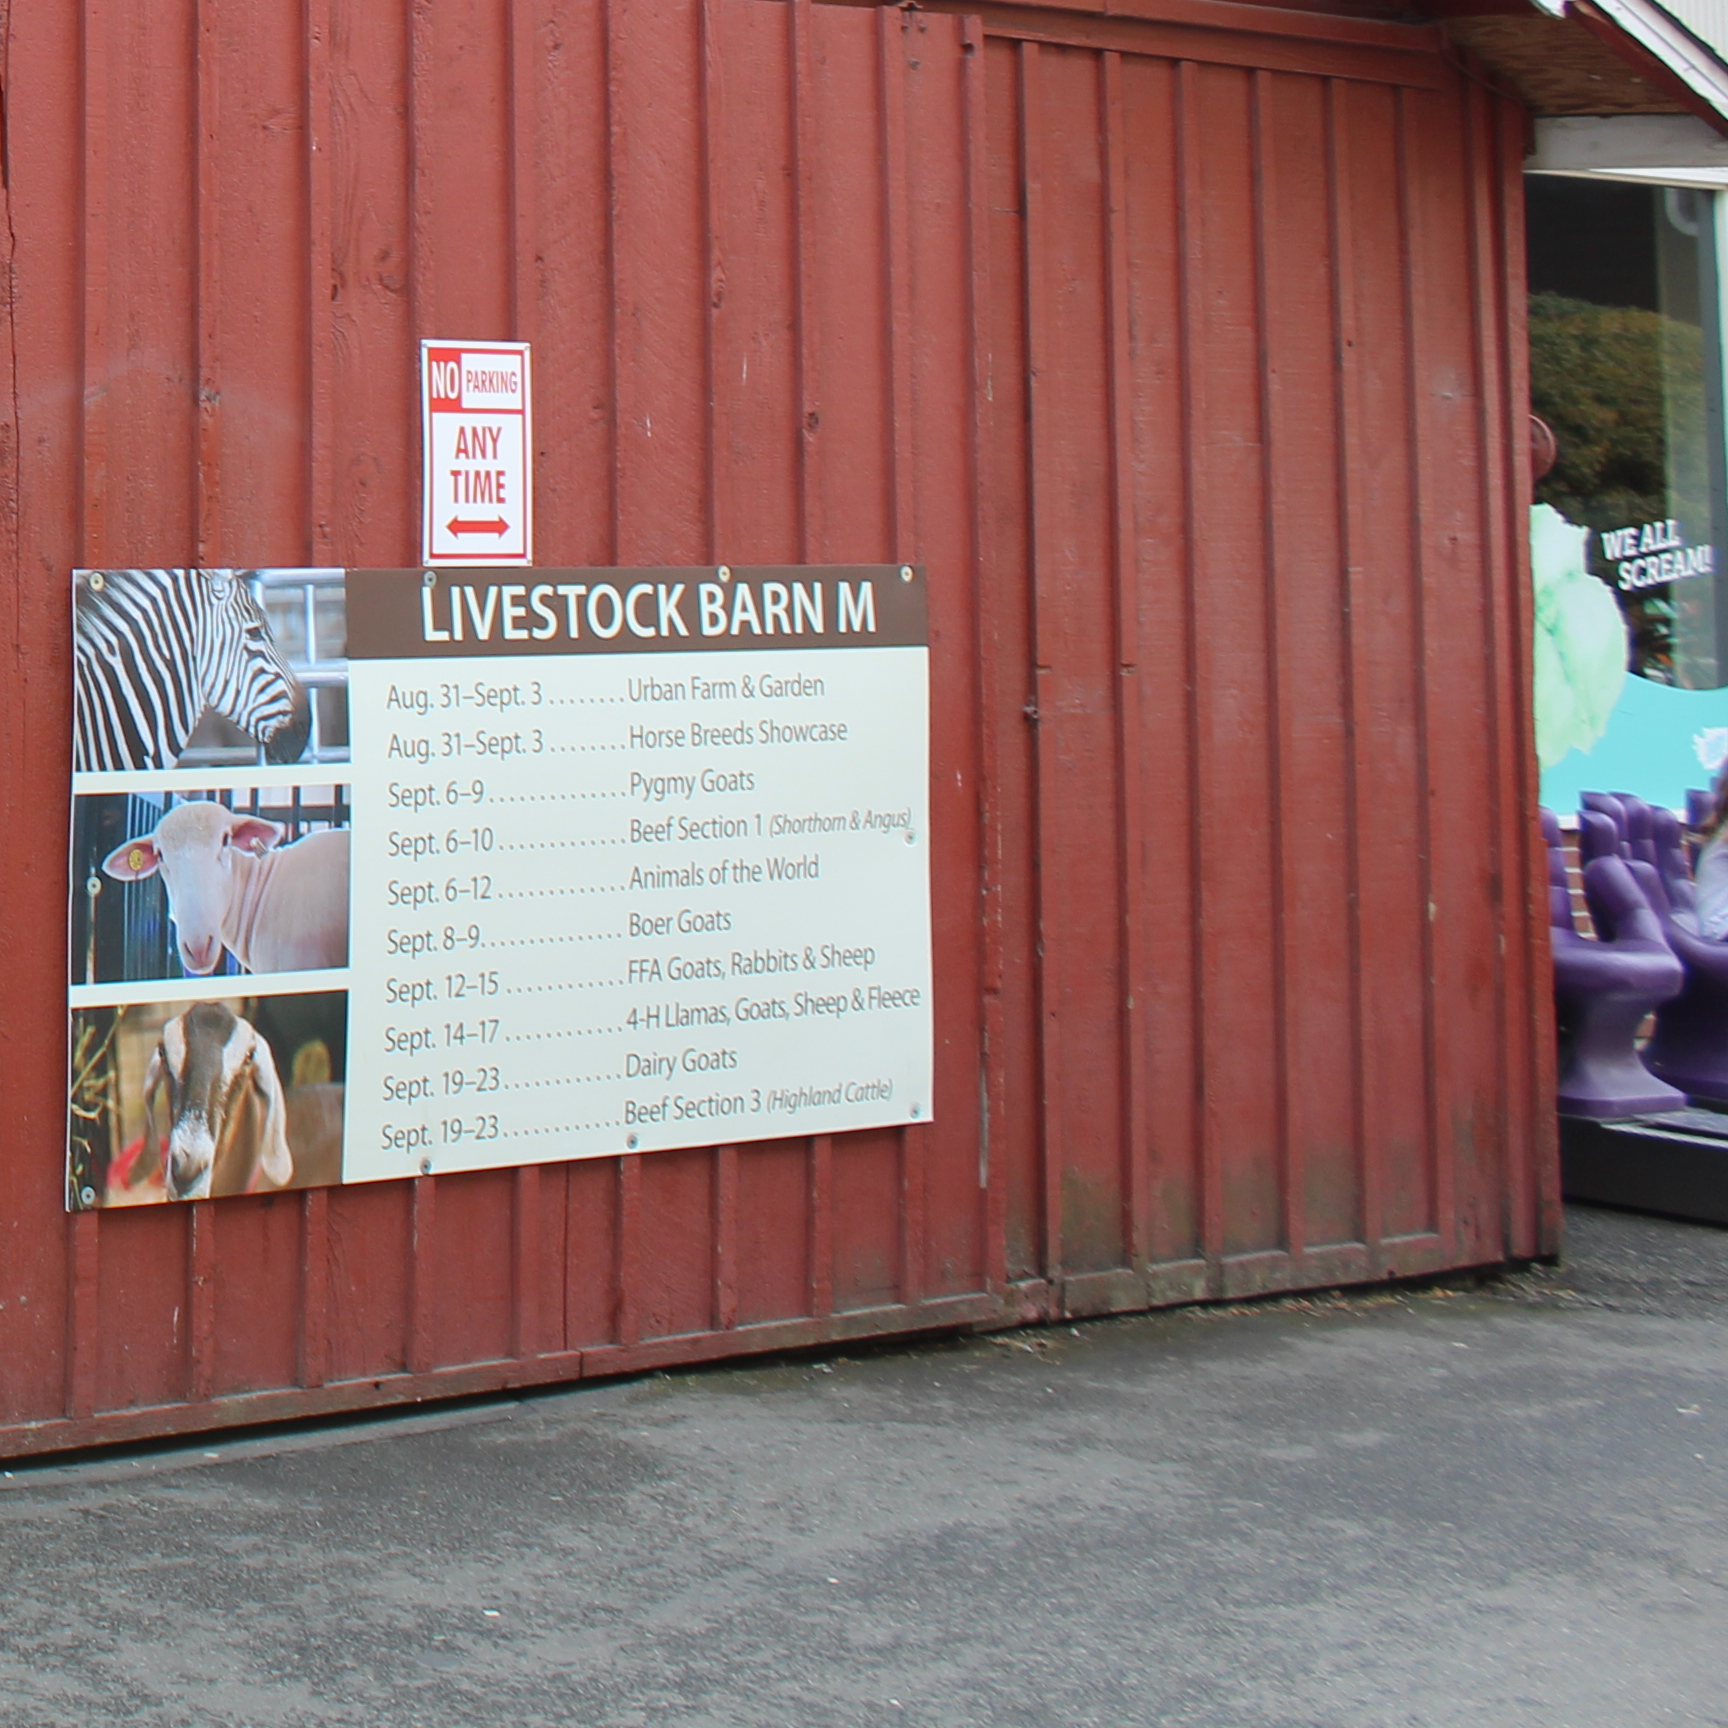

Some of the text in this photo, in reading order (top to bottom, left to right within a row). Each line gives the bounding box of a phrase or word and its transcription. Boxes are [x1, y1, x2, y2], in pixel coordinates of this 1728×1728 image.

[432, 361, 517, 399] NO PARKING
[455, 426, 502, 460] ANY
[450, 470, 506, 504] TIME
[1601, 519, 1682, 560] WE ALL
[1618, 544, 1714, 591] SCREAM!
[422, 582, 875, 642] LIVESTOCK BARN M
[387, 685, 434, 716] Aug.
[531, 681, 542, 705] 3
[628, 677, 686, 702] Urban
[691, 676, 736, 700] Farm
[741, 675, 755, 698] &
[759, 673, 824, 698] Garden
[388, 734, 435, 764] Aug.
[532, 729, 543, 753] 3
[630, 725, 685, 749] Horse
[691, 720, 754, 746] Breeds
[759, 719, 847, 744] Showcase
[389, 782, 440, 813] Sept.
[631, 772, 696, 802] Pygmy
[701, 769, 754, 792] Goats
[389, 831, 440, 862] Sept.
[631, 817, 674, 845] Beef
[678, 815, 745, 840] Section
[754, 813, 762, 837] 1
[770, 812, 846, 838] (Shorthorn
[849, 810, 861, 830] &
[863, 807, 912, 831] Angus)
[388, 880, 439, 910] Sept.
[629, 862, 704, 890] Animals
[709, 859, 729, 885] of
[732, 859, 762, 883] the
[766, 854, 819, 881] World
[387, 929, 437, 959] Sept.
[630, 913, 673, 937] Boer
[678, 909, 731, 933] Goats
[386, 978, 437, 1008] Sept.
[629, 958, 662, 984] FFA
[667, 957, 726, 980] Goats,
[732, 949, 798, 976] Rabbits
[803, 946, 816, 970] &
[820, 944, 875, 971] Sheep
[385, 1027, 436, 1057] Sept.
[626, 1005, 660, 1030] 4-H
[665, 1002, 731, 1027] Llamas,
[735, 997, 789, 1021] Goats,
[794, 991, 848, 1019] Sheep
[851, 988, 865, 1011] &
[868, 985, 920, 1010] Fleece
[383, 1076, 434, 1105] Sept.
[626, 1052, 677, 1081] Dairy
[682, 1048, 737, 1072] Goats
[381, 1124, 432, 1154] Sept.
[625, 1096, 667, 1125] Beef
[673, 1093, 744, 1120] Section
[750, 1089, 761, 1112] 3
[767, 1083, 842, 1114] (Highland
[845, 1078, 893, 1103] Cattle)
